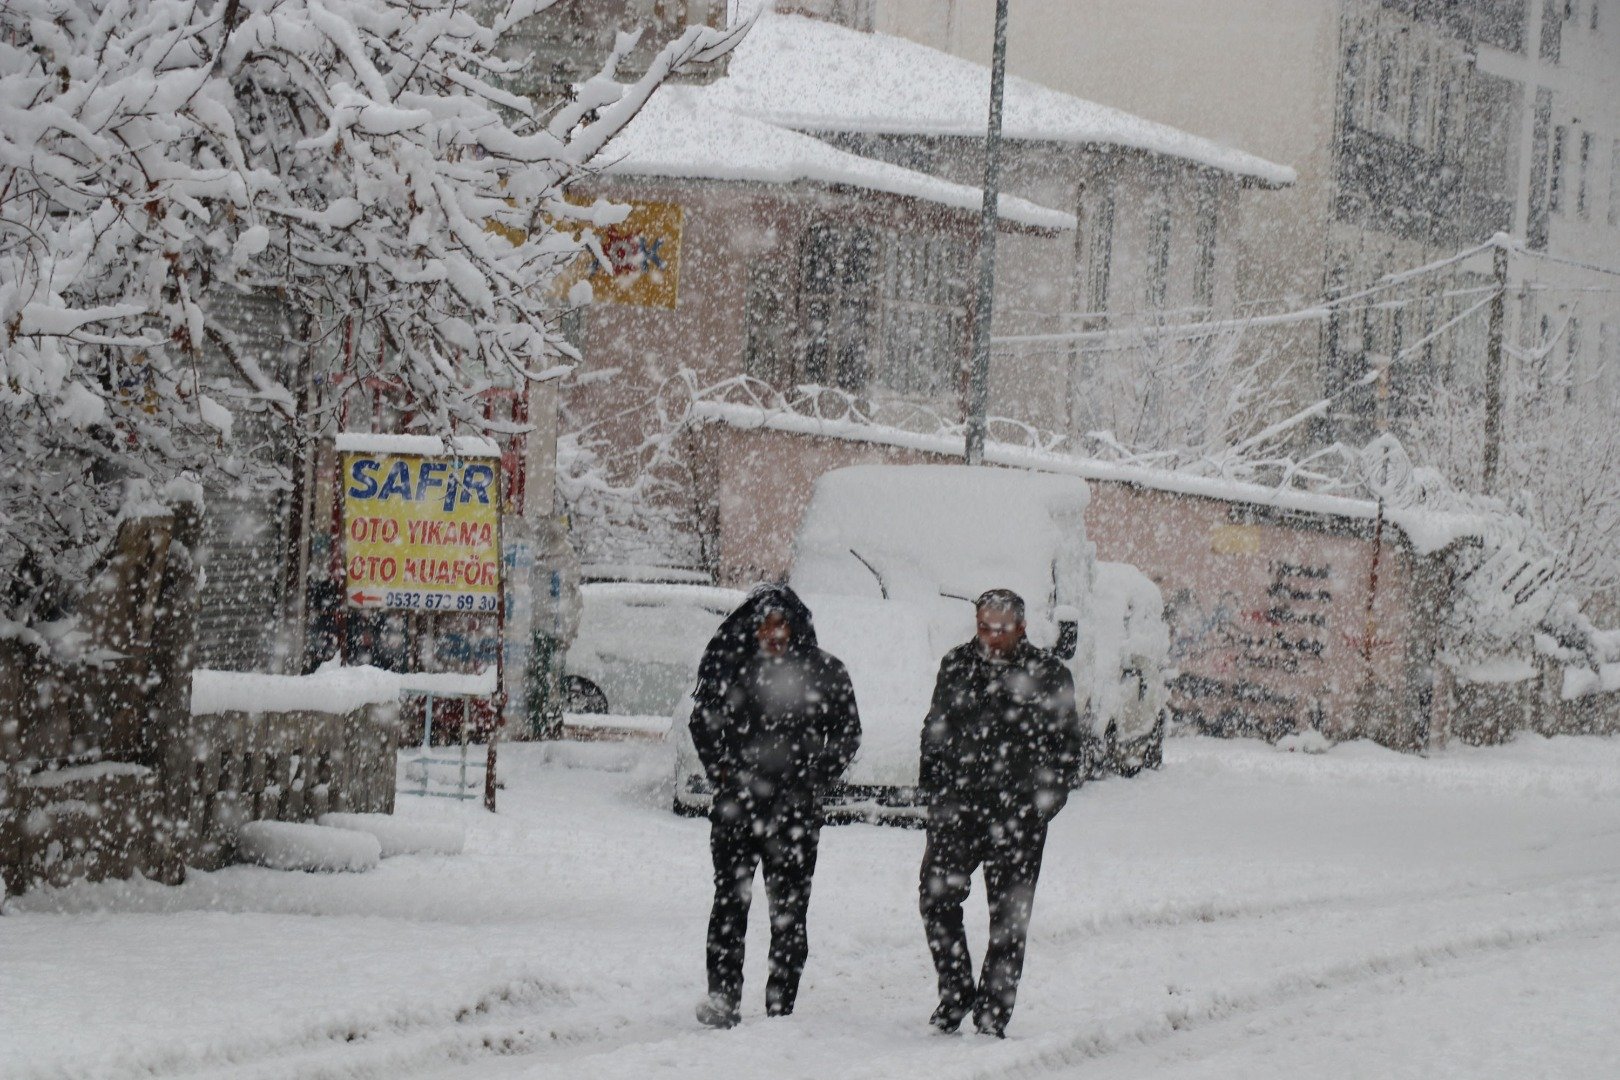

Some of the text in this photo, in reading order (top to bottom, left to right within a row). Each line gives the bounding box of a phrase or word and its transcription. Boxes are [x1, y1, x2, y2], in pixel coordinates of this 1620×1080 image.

[351, 516, 493, 547] OTO YIKAMA
[350, 555, 397, 582] OTO
[386, 591, 420, 609] 0532
[456, 594, 474, 611] 69
[478, 595, 497, 611] 30
